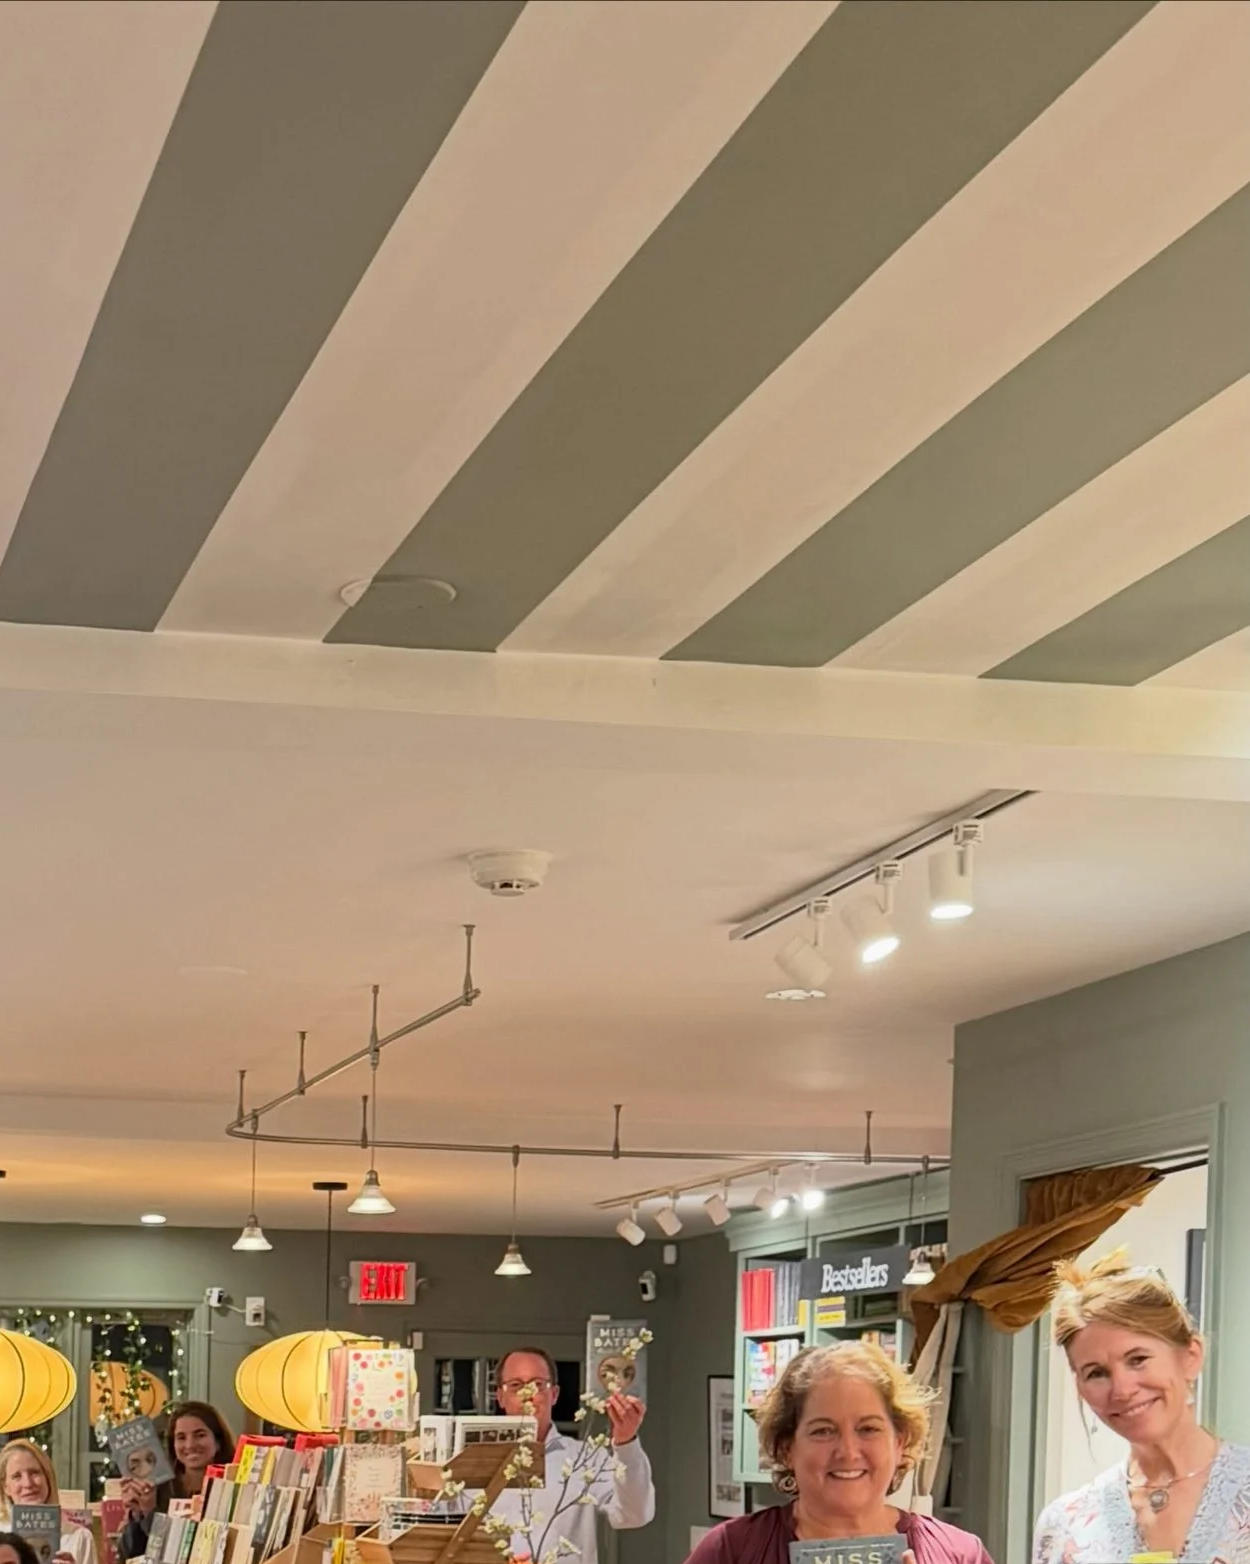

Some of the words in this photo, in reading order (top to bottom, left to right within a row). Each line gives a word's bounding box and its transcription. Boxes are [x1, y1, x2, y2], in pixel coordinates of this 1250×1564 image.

[360, 1262, 408, 1301] EXIT
[821, 1256, 889, 1293] Bestsellers
[594, 1338, 630, 1348] BATE
